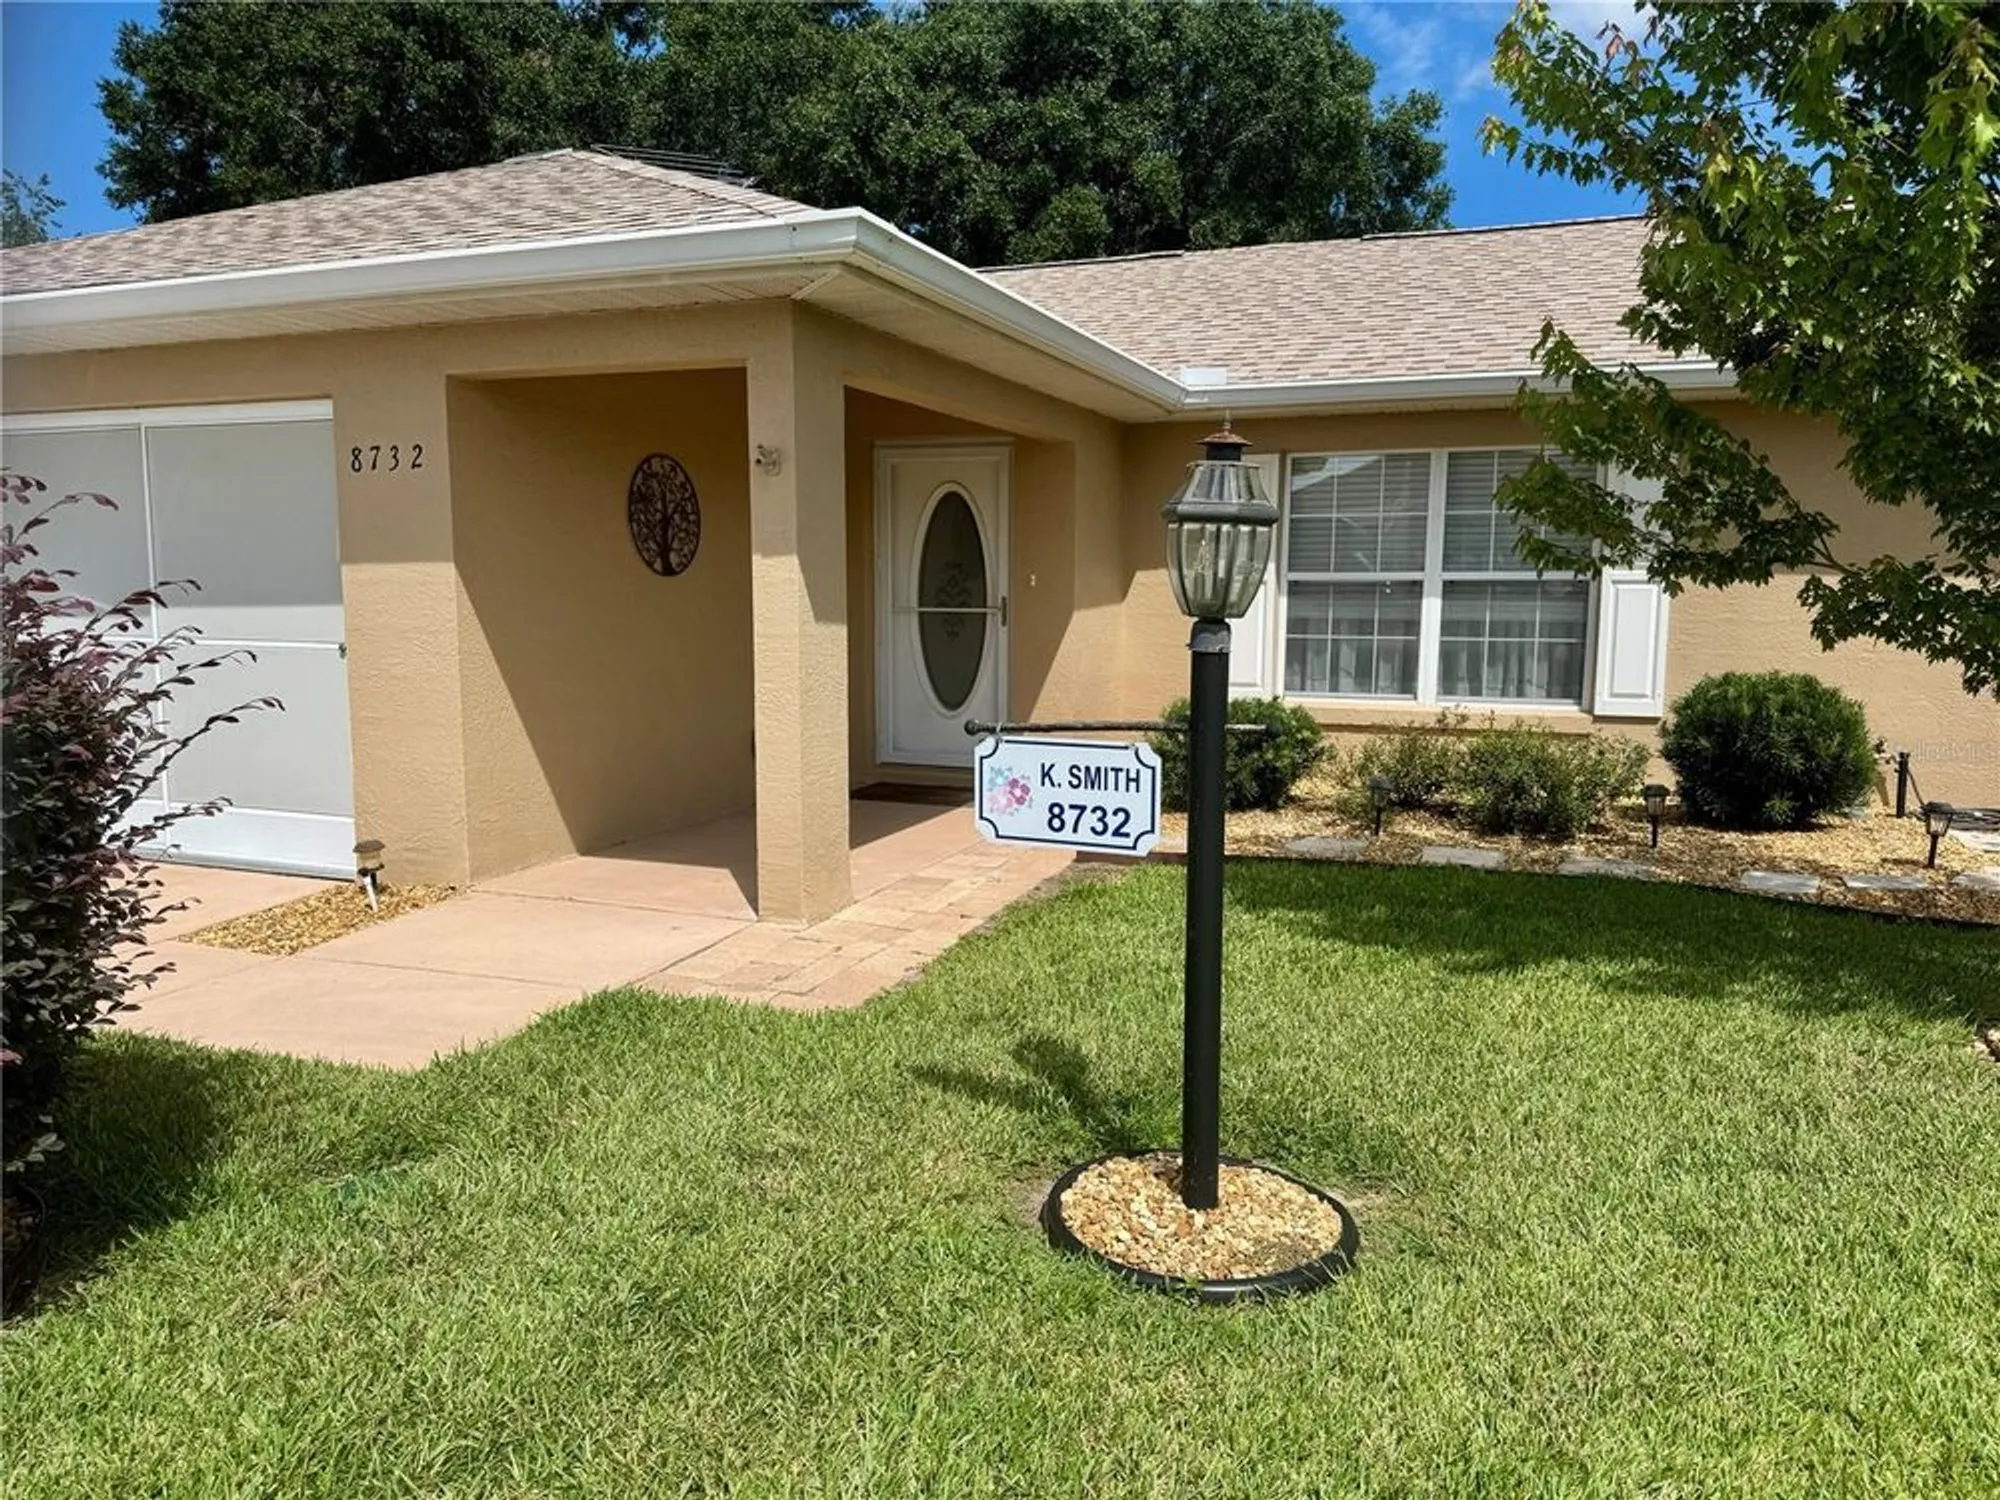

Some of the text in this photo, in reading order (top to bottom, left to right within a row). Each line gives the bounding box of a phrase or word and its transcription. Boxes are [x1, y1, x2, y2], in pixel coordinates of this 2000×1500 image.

[351, 444, 423, 472] 8732
[1040, 763, 1141, 793] K. SMITH
[1047, 802, 1131, 838] 8732
